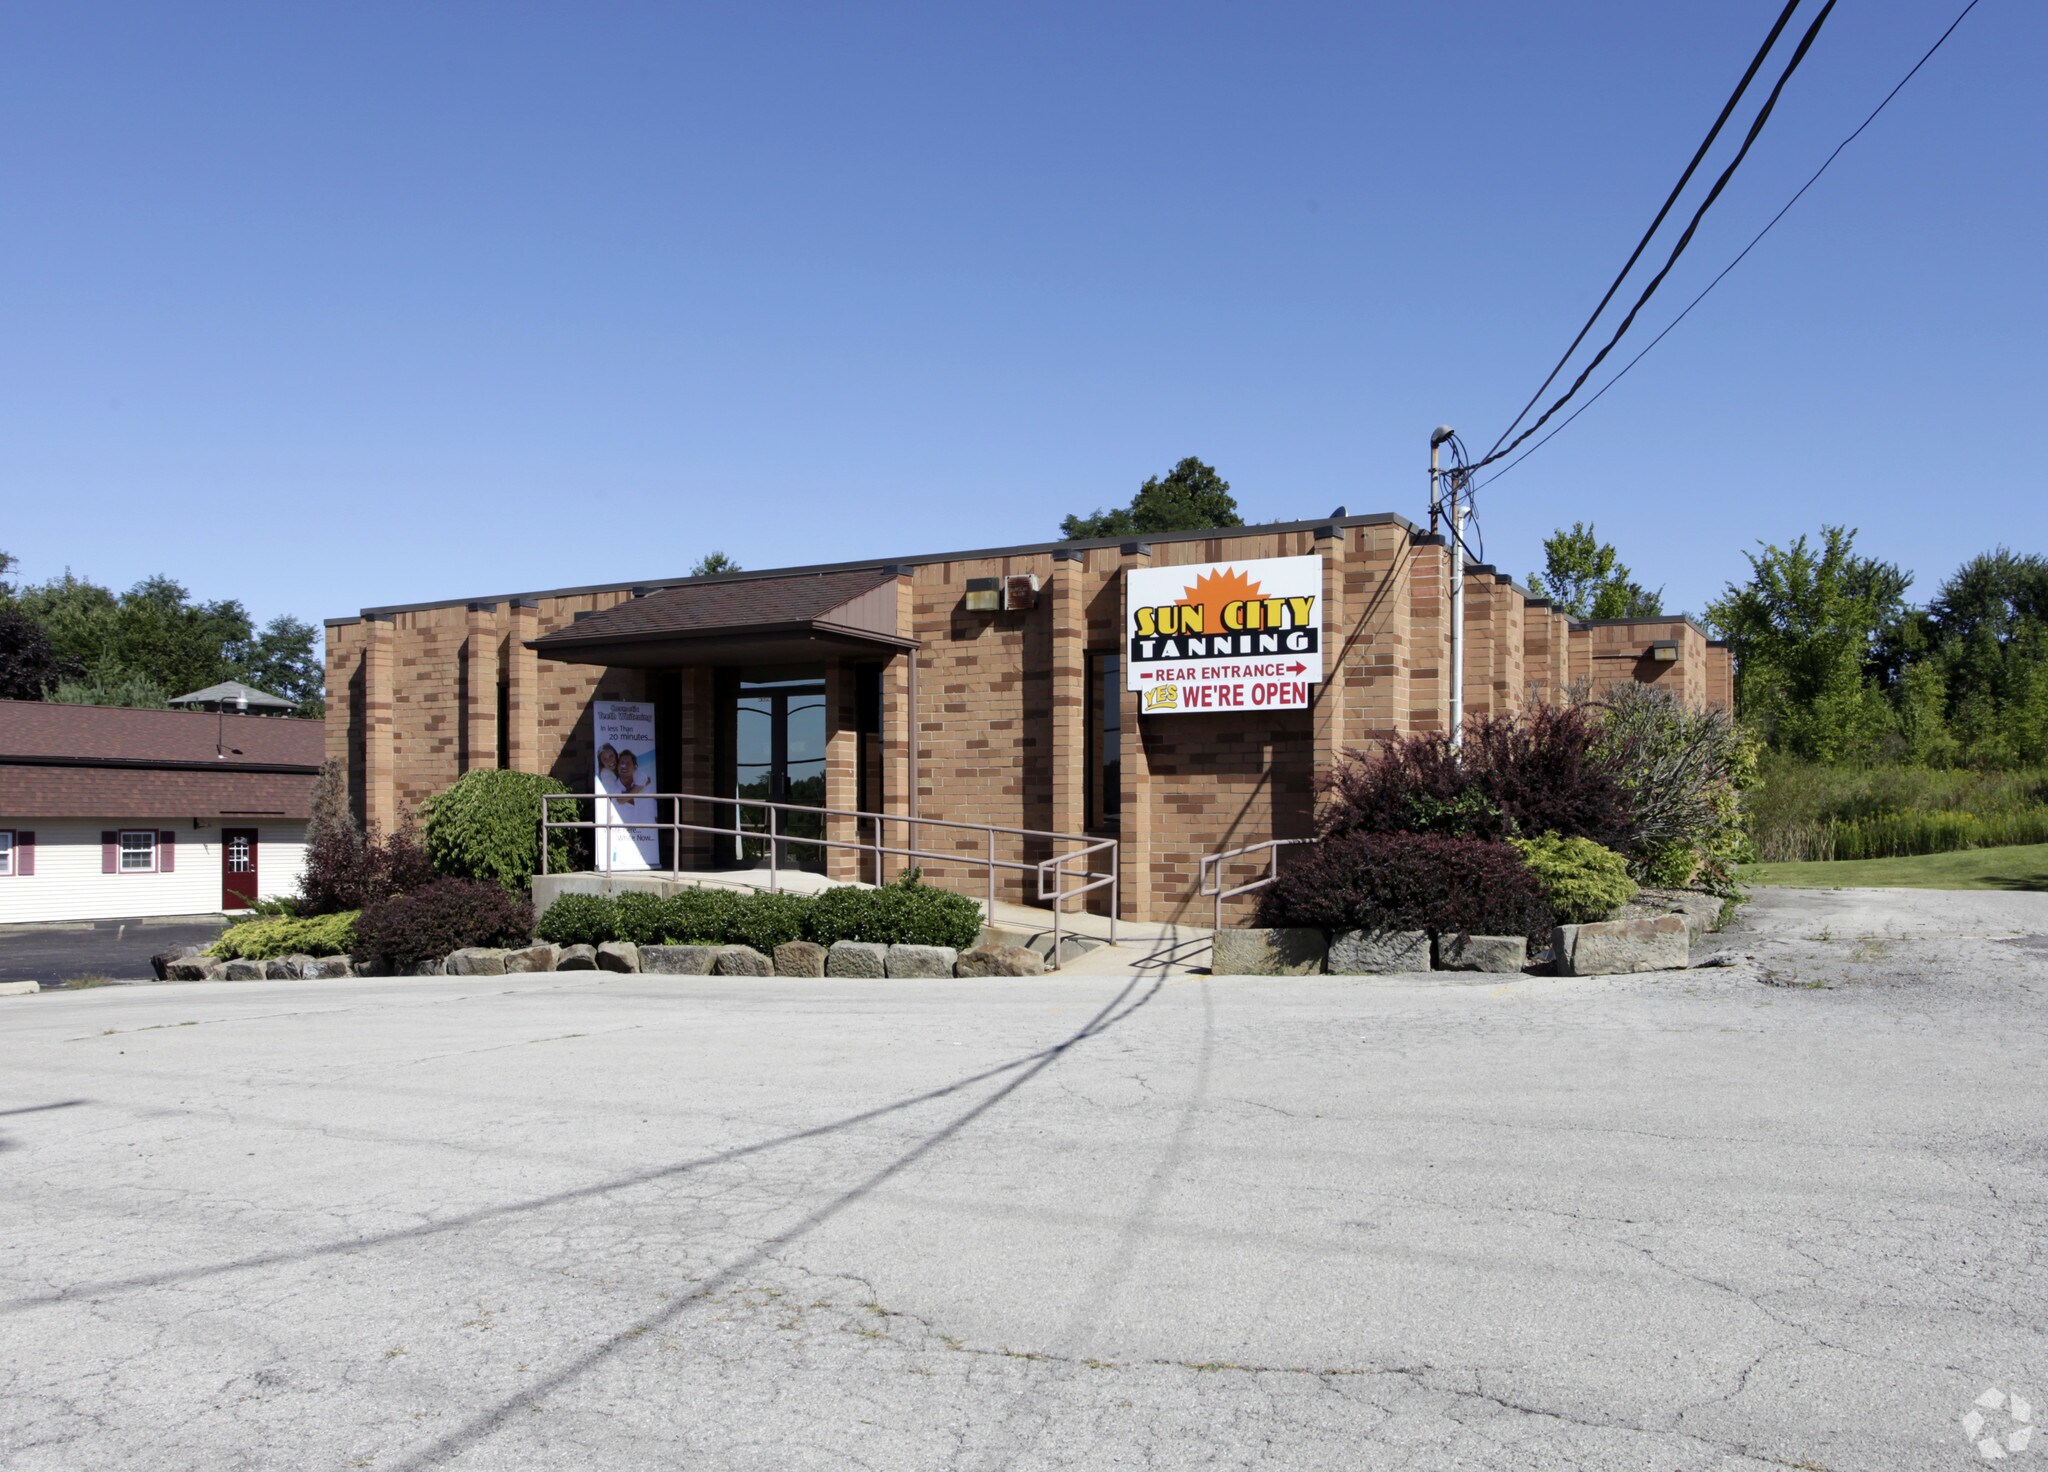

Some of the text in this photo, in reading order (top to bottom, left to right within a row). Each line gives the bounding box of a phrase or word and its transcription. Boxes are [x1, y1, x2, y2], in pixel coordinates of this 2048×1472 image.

[1134, 595, 1315, 637] SUN CITY
[1140, 631, 1309, 658] TANNING
[1156, 663, 1285, 681] REAR ENTRANCE
[1144, 682, 1306, 708] YES WE'RE OPEN
[609, 733, 618, 741] 20
